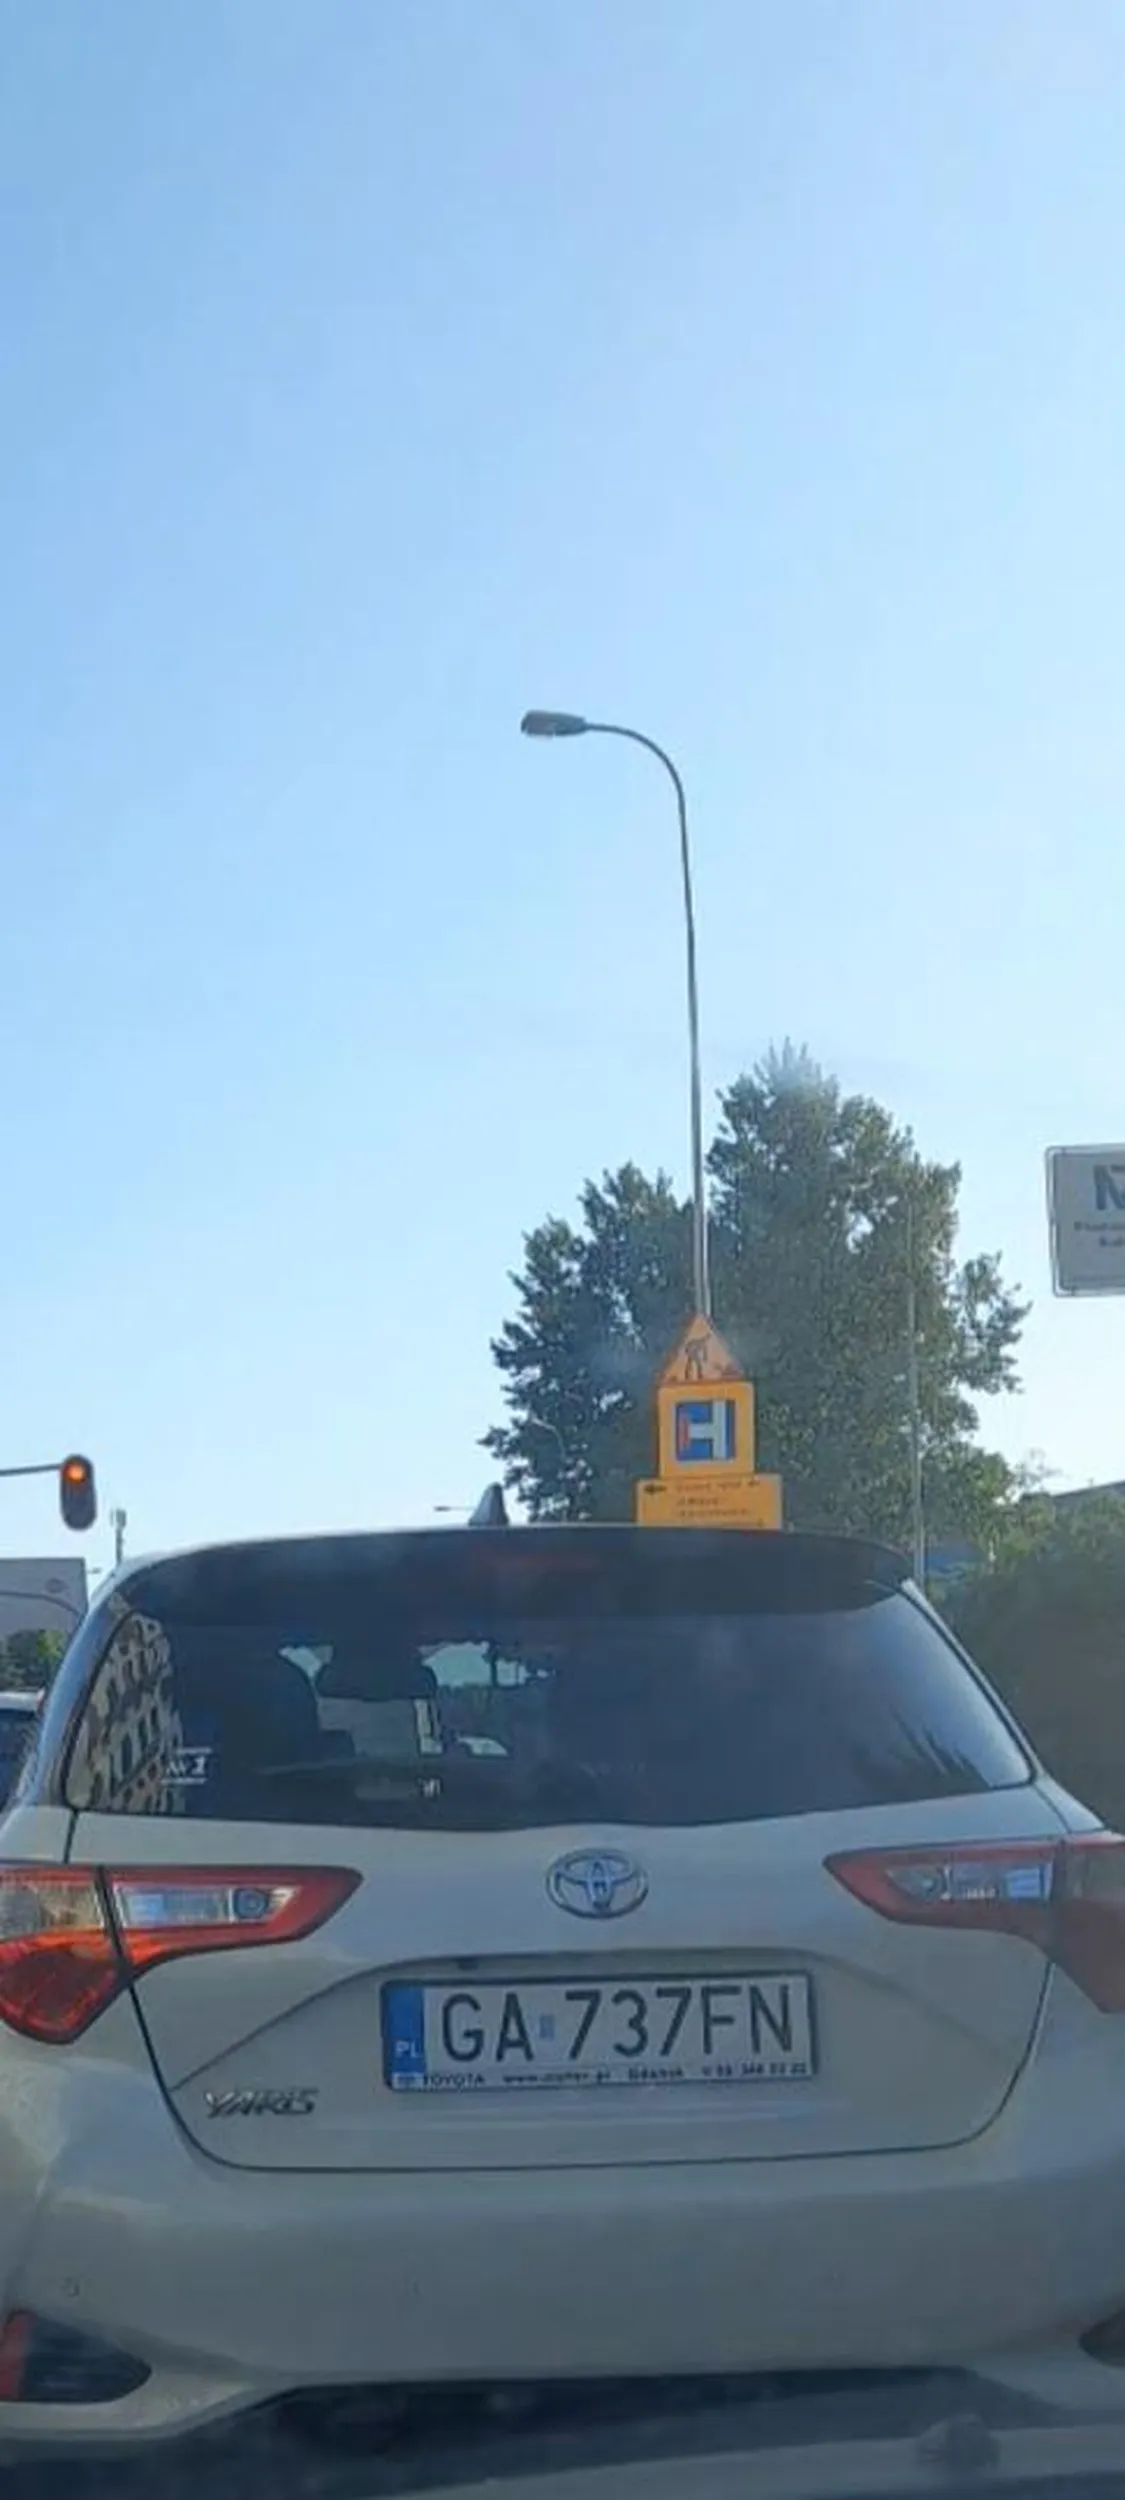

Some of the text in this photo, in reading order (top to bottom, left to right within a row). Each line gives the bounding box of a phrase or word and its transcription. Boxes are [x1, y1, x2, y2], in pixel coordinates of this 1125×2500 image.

[442, 1984, 793, 2062] GA 737FN
[395, 2040, 421, 2058] PL
[423, 2073, 486, 2088] TOYOTA
[203, 2088, 319, 2118] YARIS
